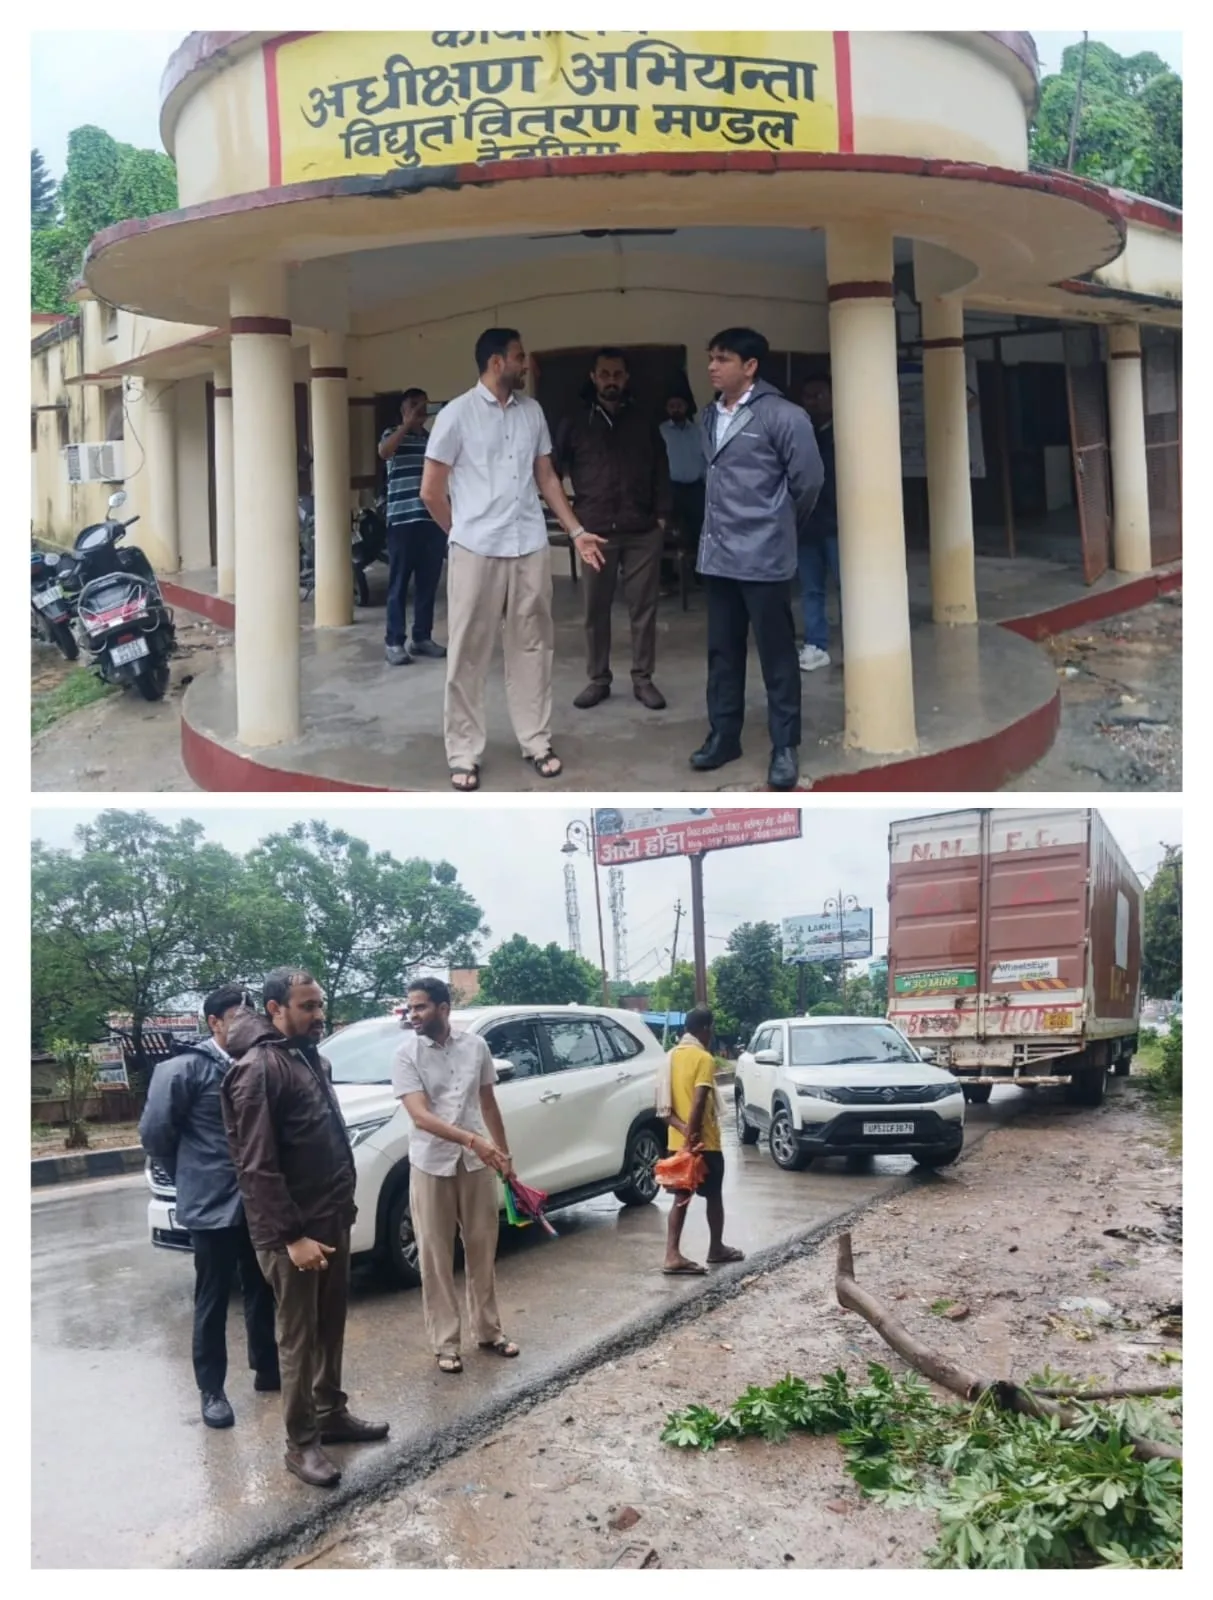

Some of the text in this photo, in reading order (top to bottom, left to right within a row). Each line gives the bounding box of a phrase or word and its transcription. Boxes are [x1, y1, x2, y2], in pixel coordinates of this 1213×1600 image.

[300, 39, 818, 128] अधीक्षण अभियन्ता
[338, 118, 457, 168] विद्युत
[459, 97, 640, 140] वितरण
[652, 104, 799, 150] मण्डल
